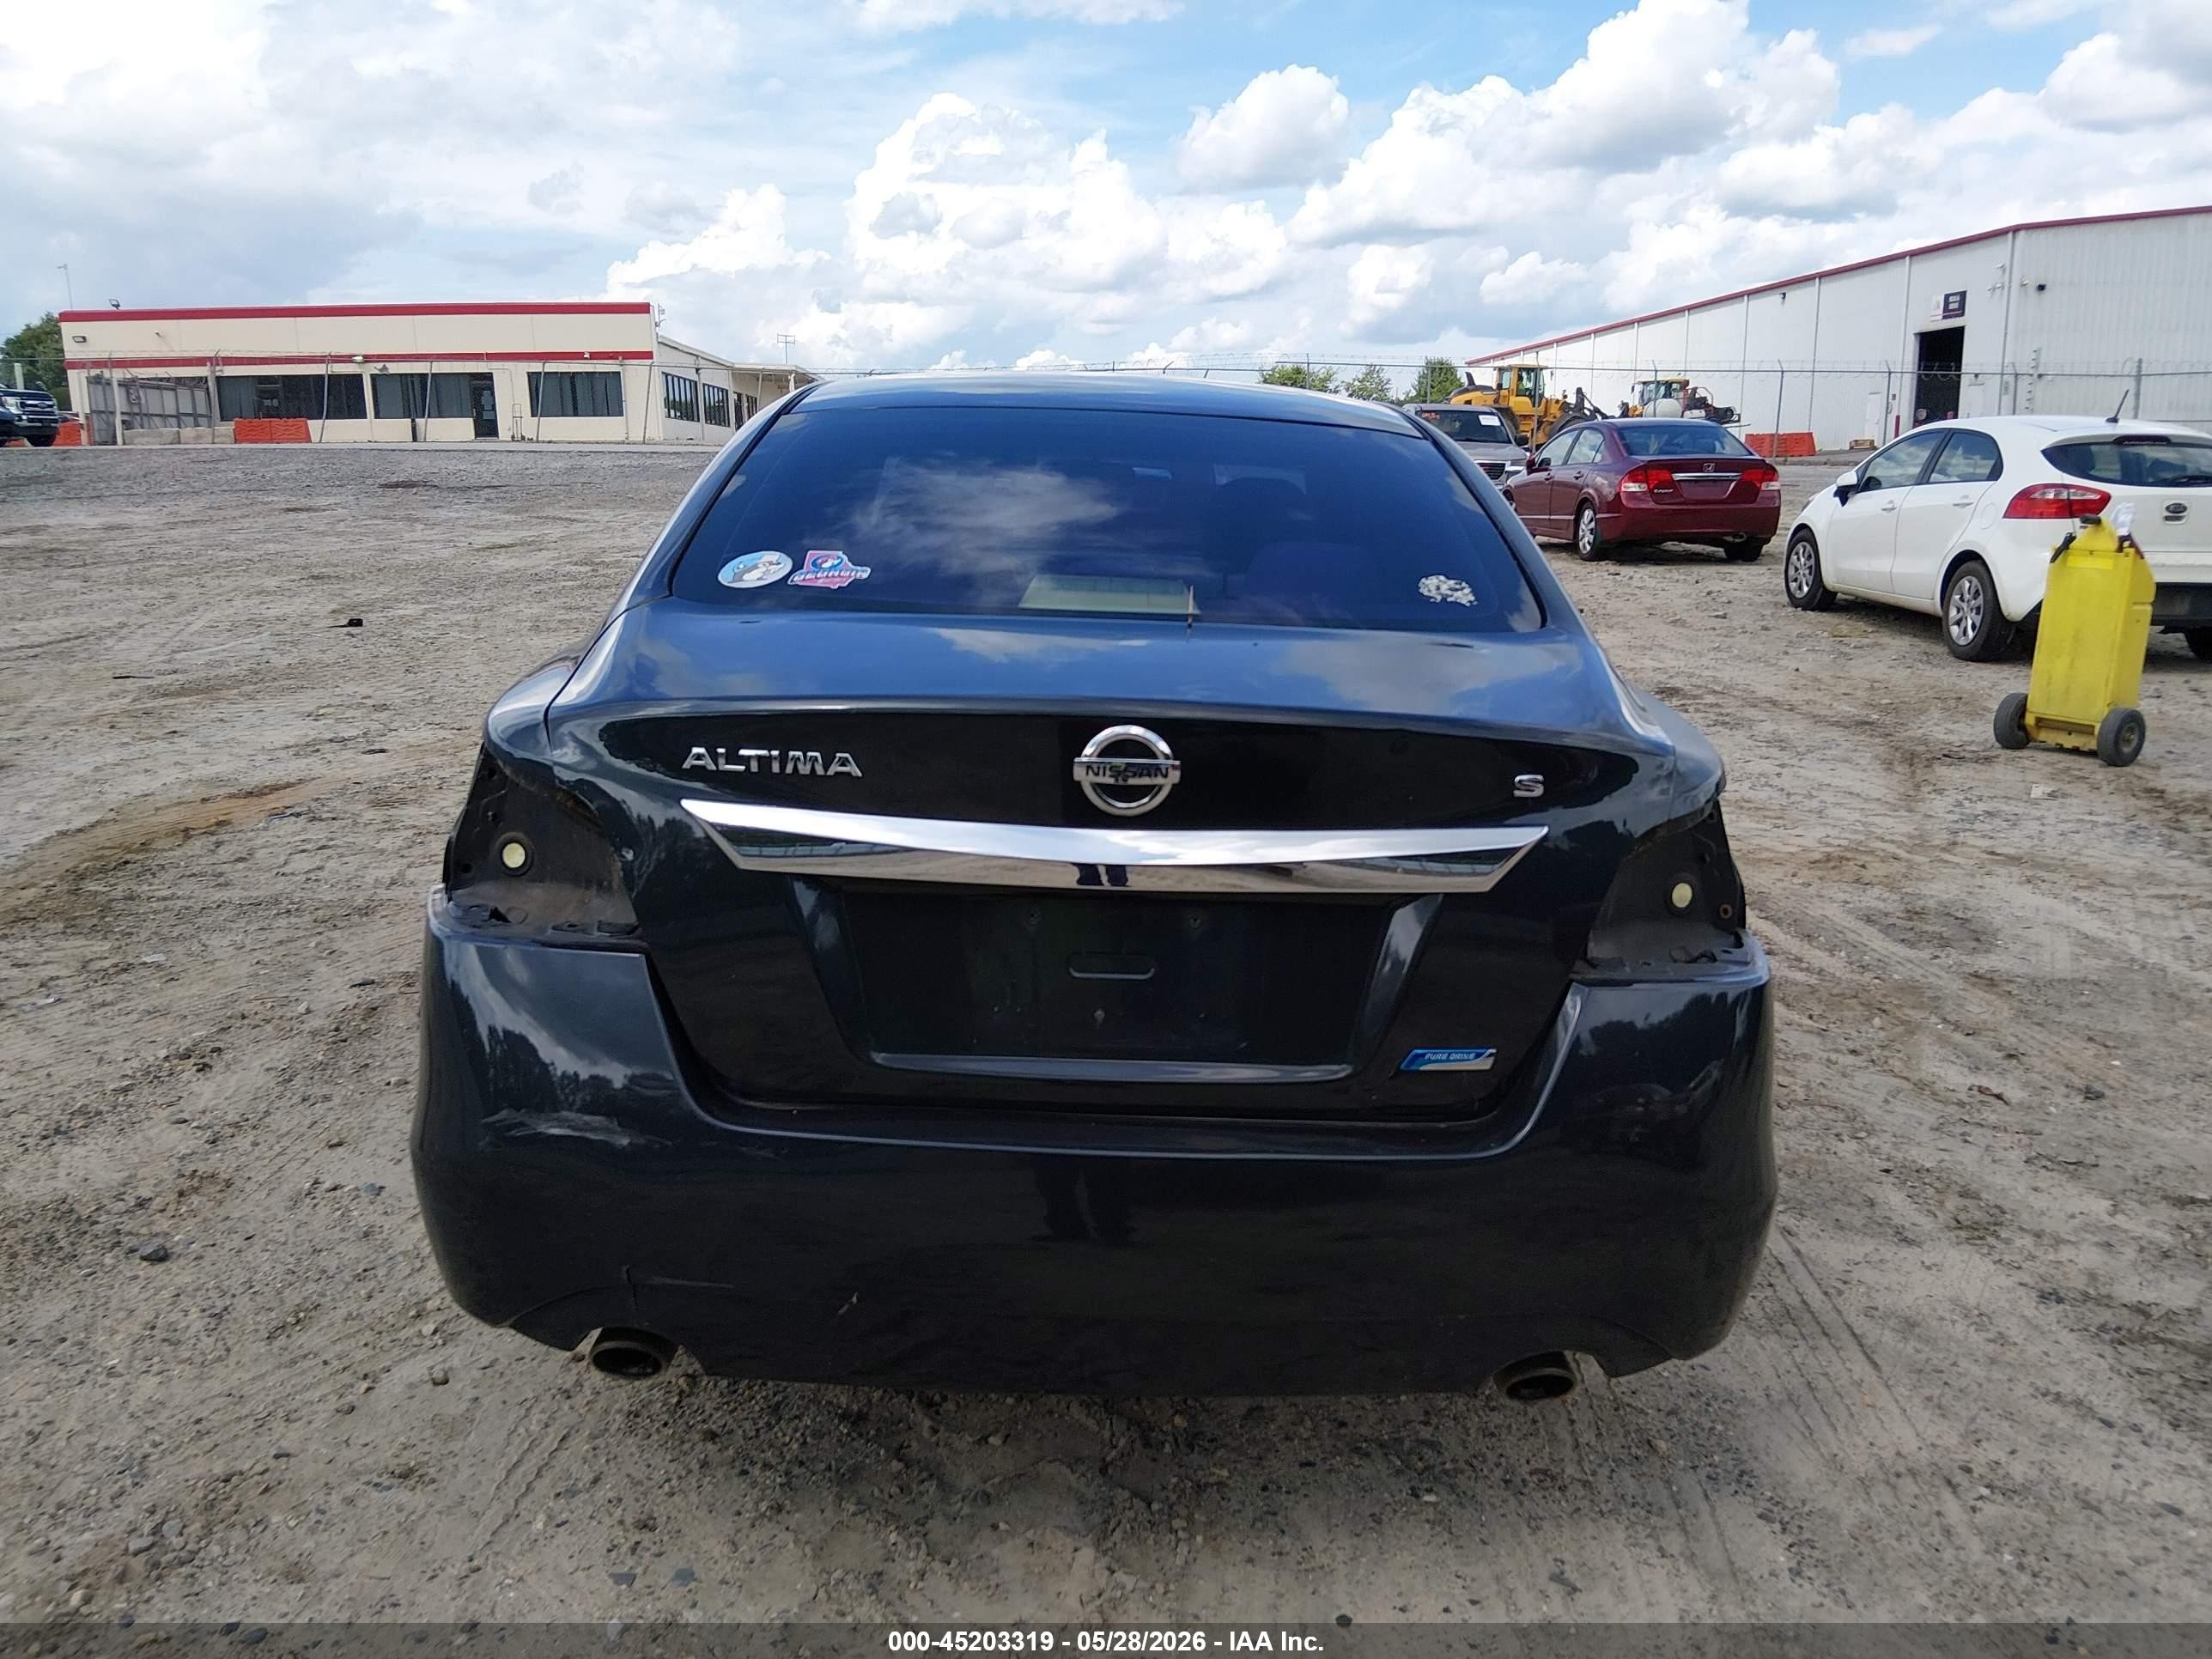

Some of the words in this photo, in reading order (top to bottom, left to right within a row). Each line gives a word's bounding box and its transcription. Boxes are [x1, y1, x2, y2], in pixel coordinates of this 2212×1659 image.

[682, 747, 862, 777] ALTIMA
[1085, 763, 1169, 779] NISSAN
[1513, 774, 1545, 798] S
[1424, 1052, 1449, 1060] PURE
[1449, 1052, 1477, 1060] DRIVE
